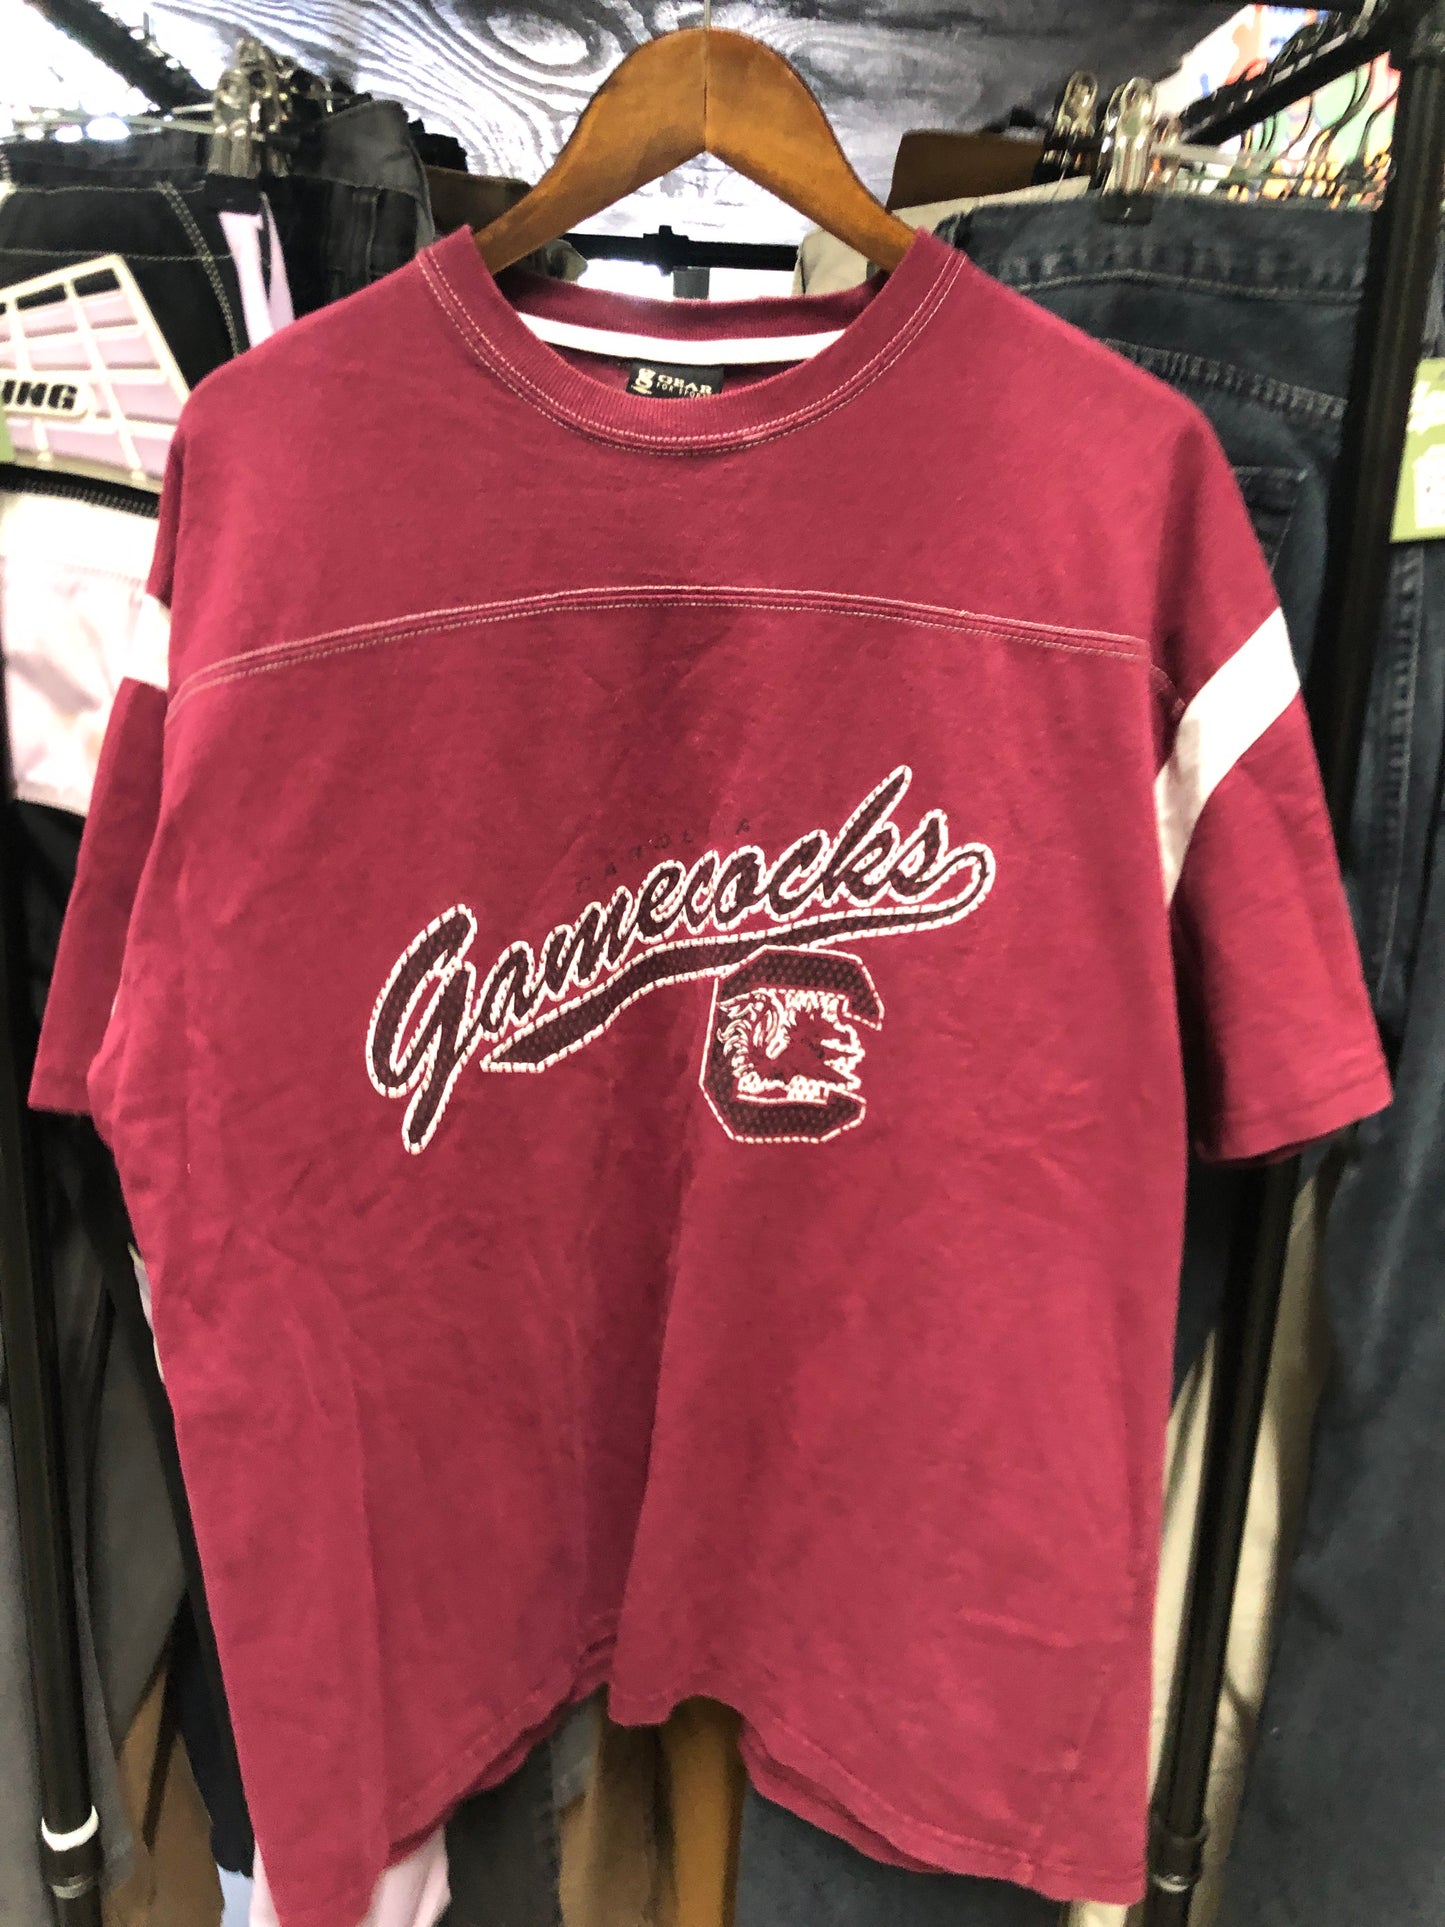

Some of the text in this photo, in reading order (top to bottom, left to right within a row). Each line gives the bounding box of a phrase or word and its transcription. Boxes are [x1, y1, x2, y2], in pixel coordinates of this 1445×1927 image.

[656, 381, 673, 392] FOR
[657, 374, 712, 395] GEAR
[366, 765, 996, 1155] Gamecocks
